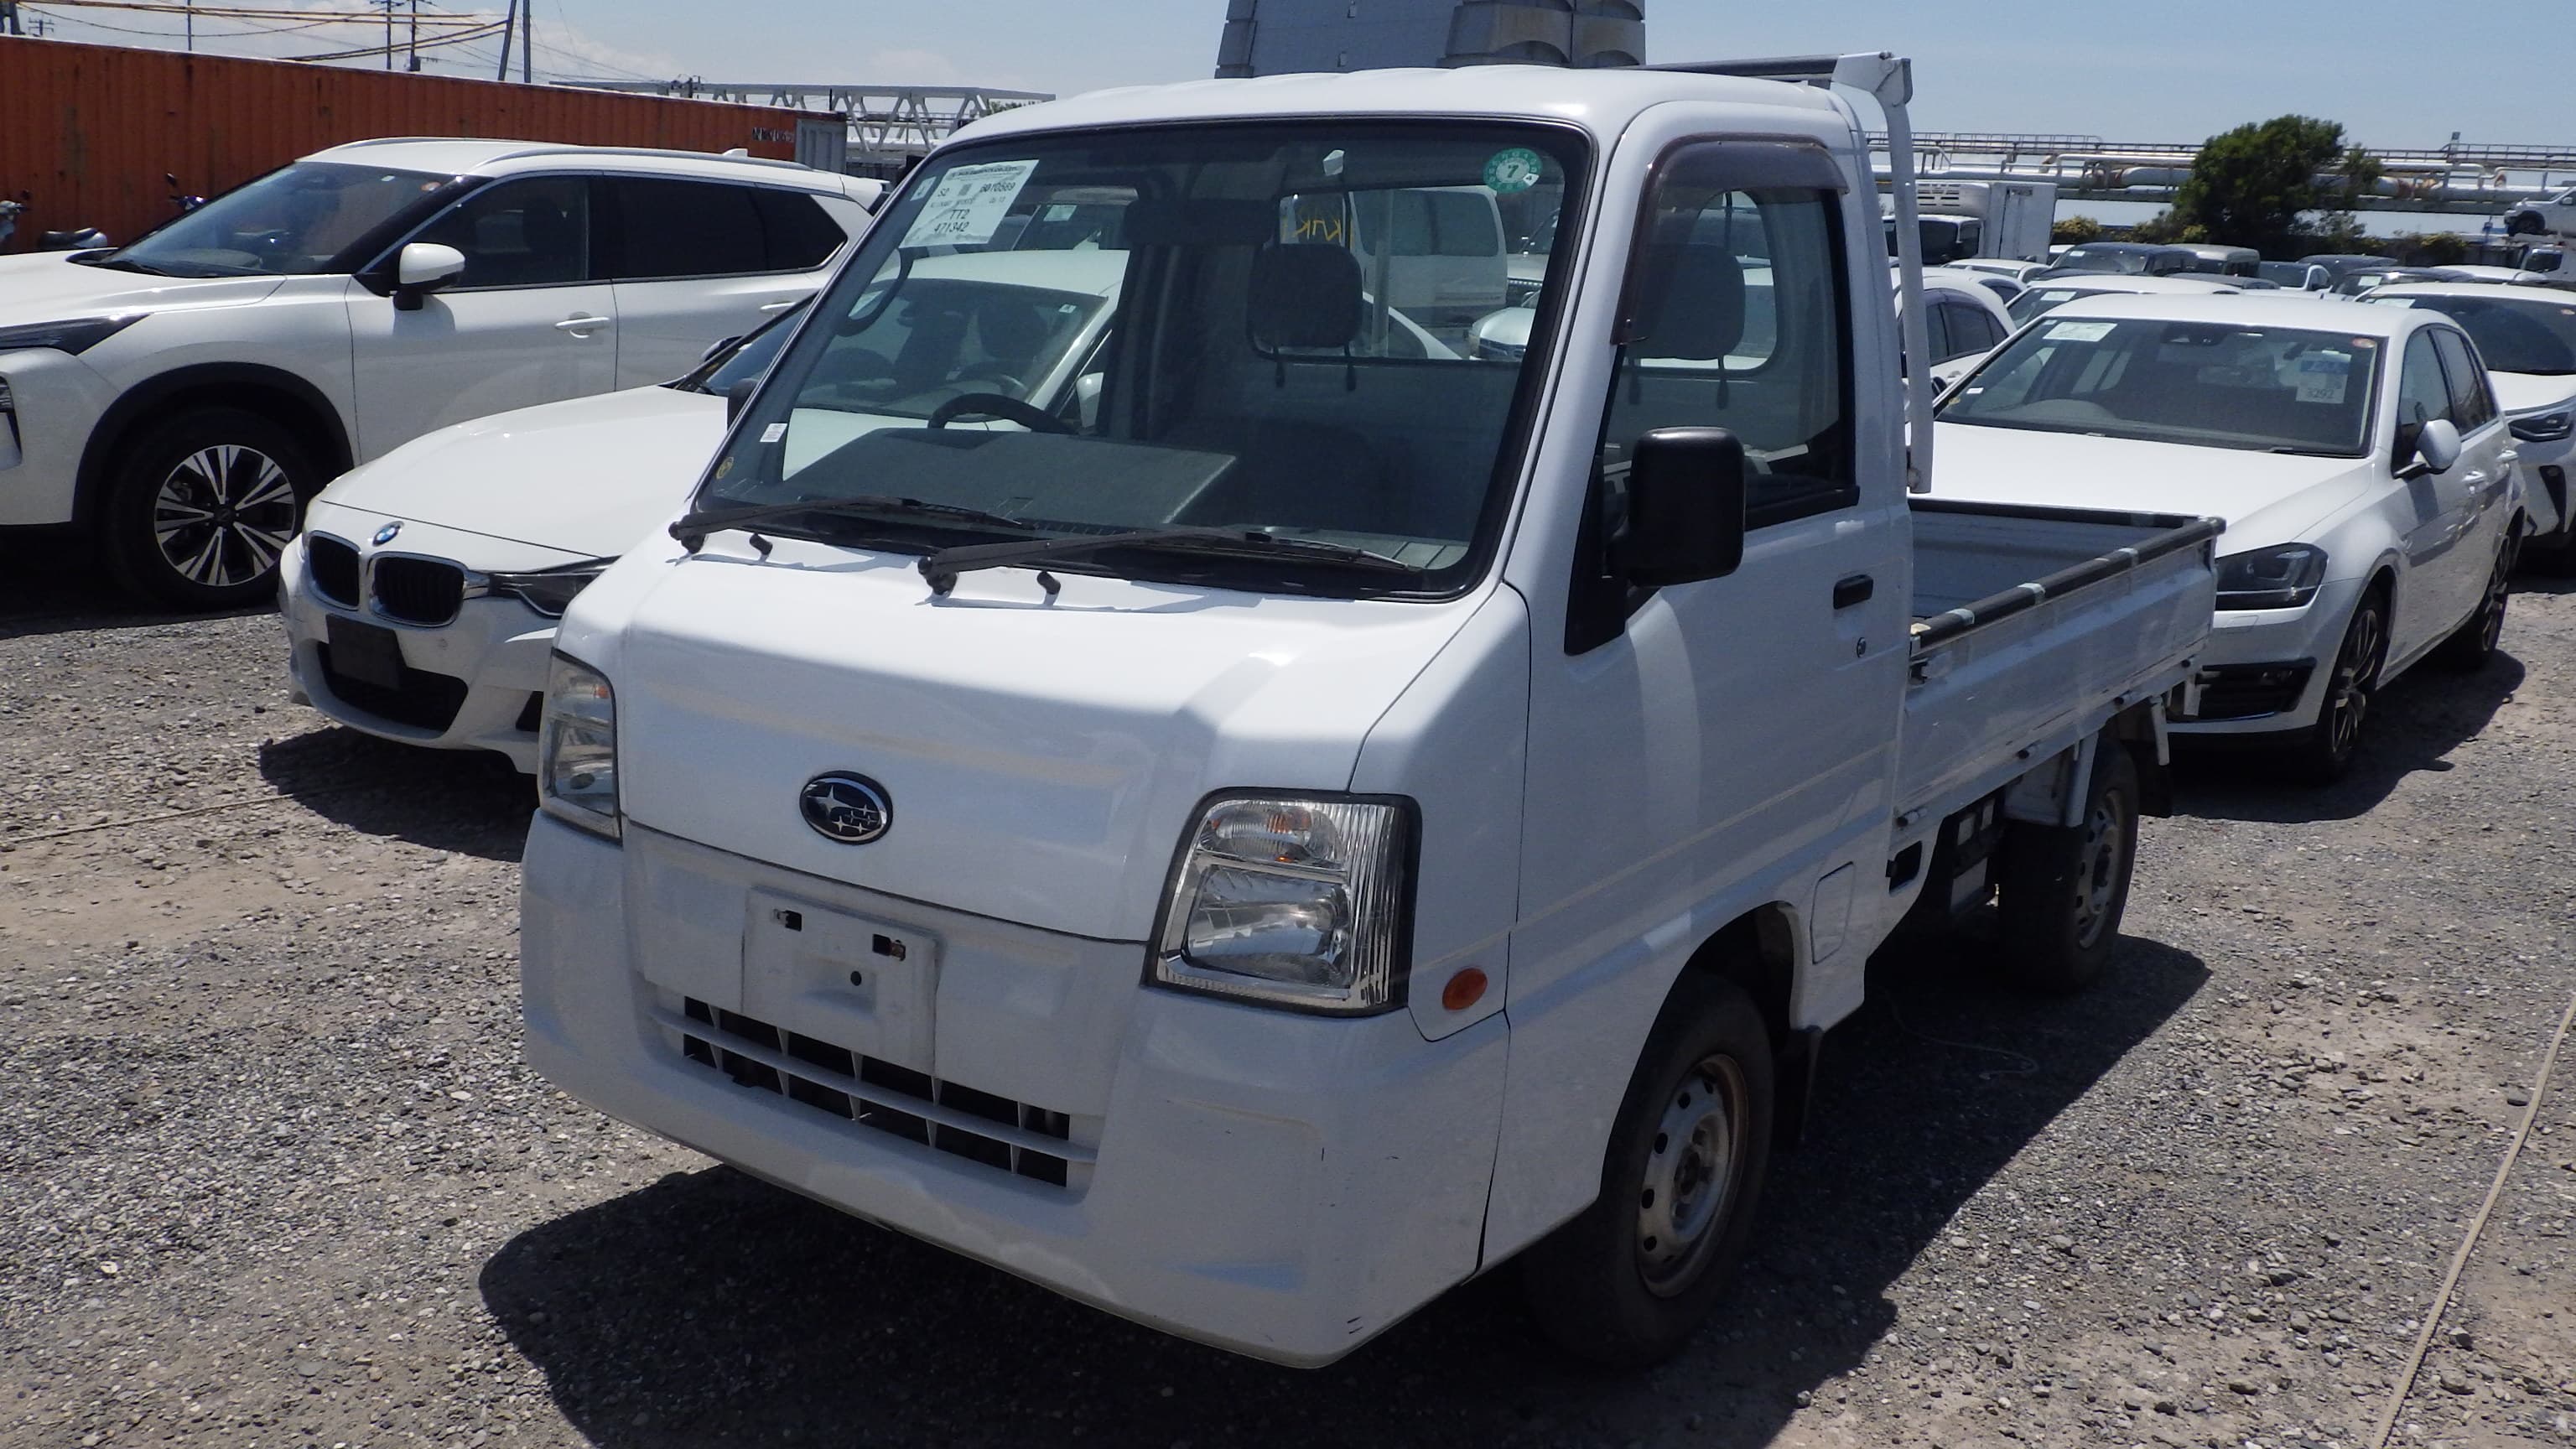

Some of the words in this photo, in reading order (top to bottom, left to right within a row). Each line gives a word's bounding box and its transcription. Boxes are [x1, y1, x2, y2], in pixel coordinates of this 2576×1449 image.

[1507, 164, 1519, 178] 7
[949, 209, 970, 220] TT2
[934, 221, 970, 232] 471342
